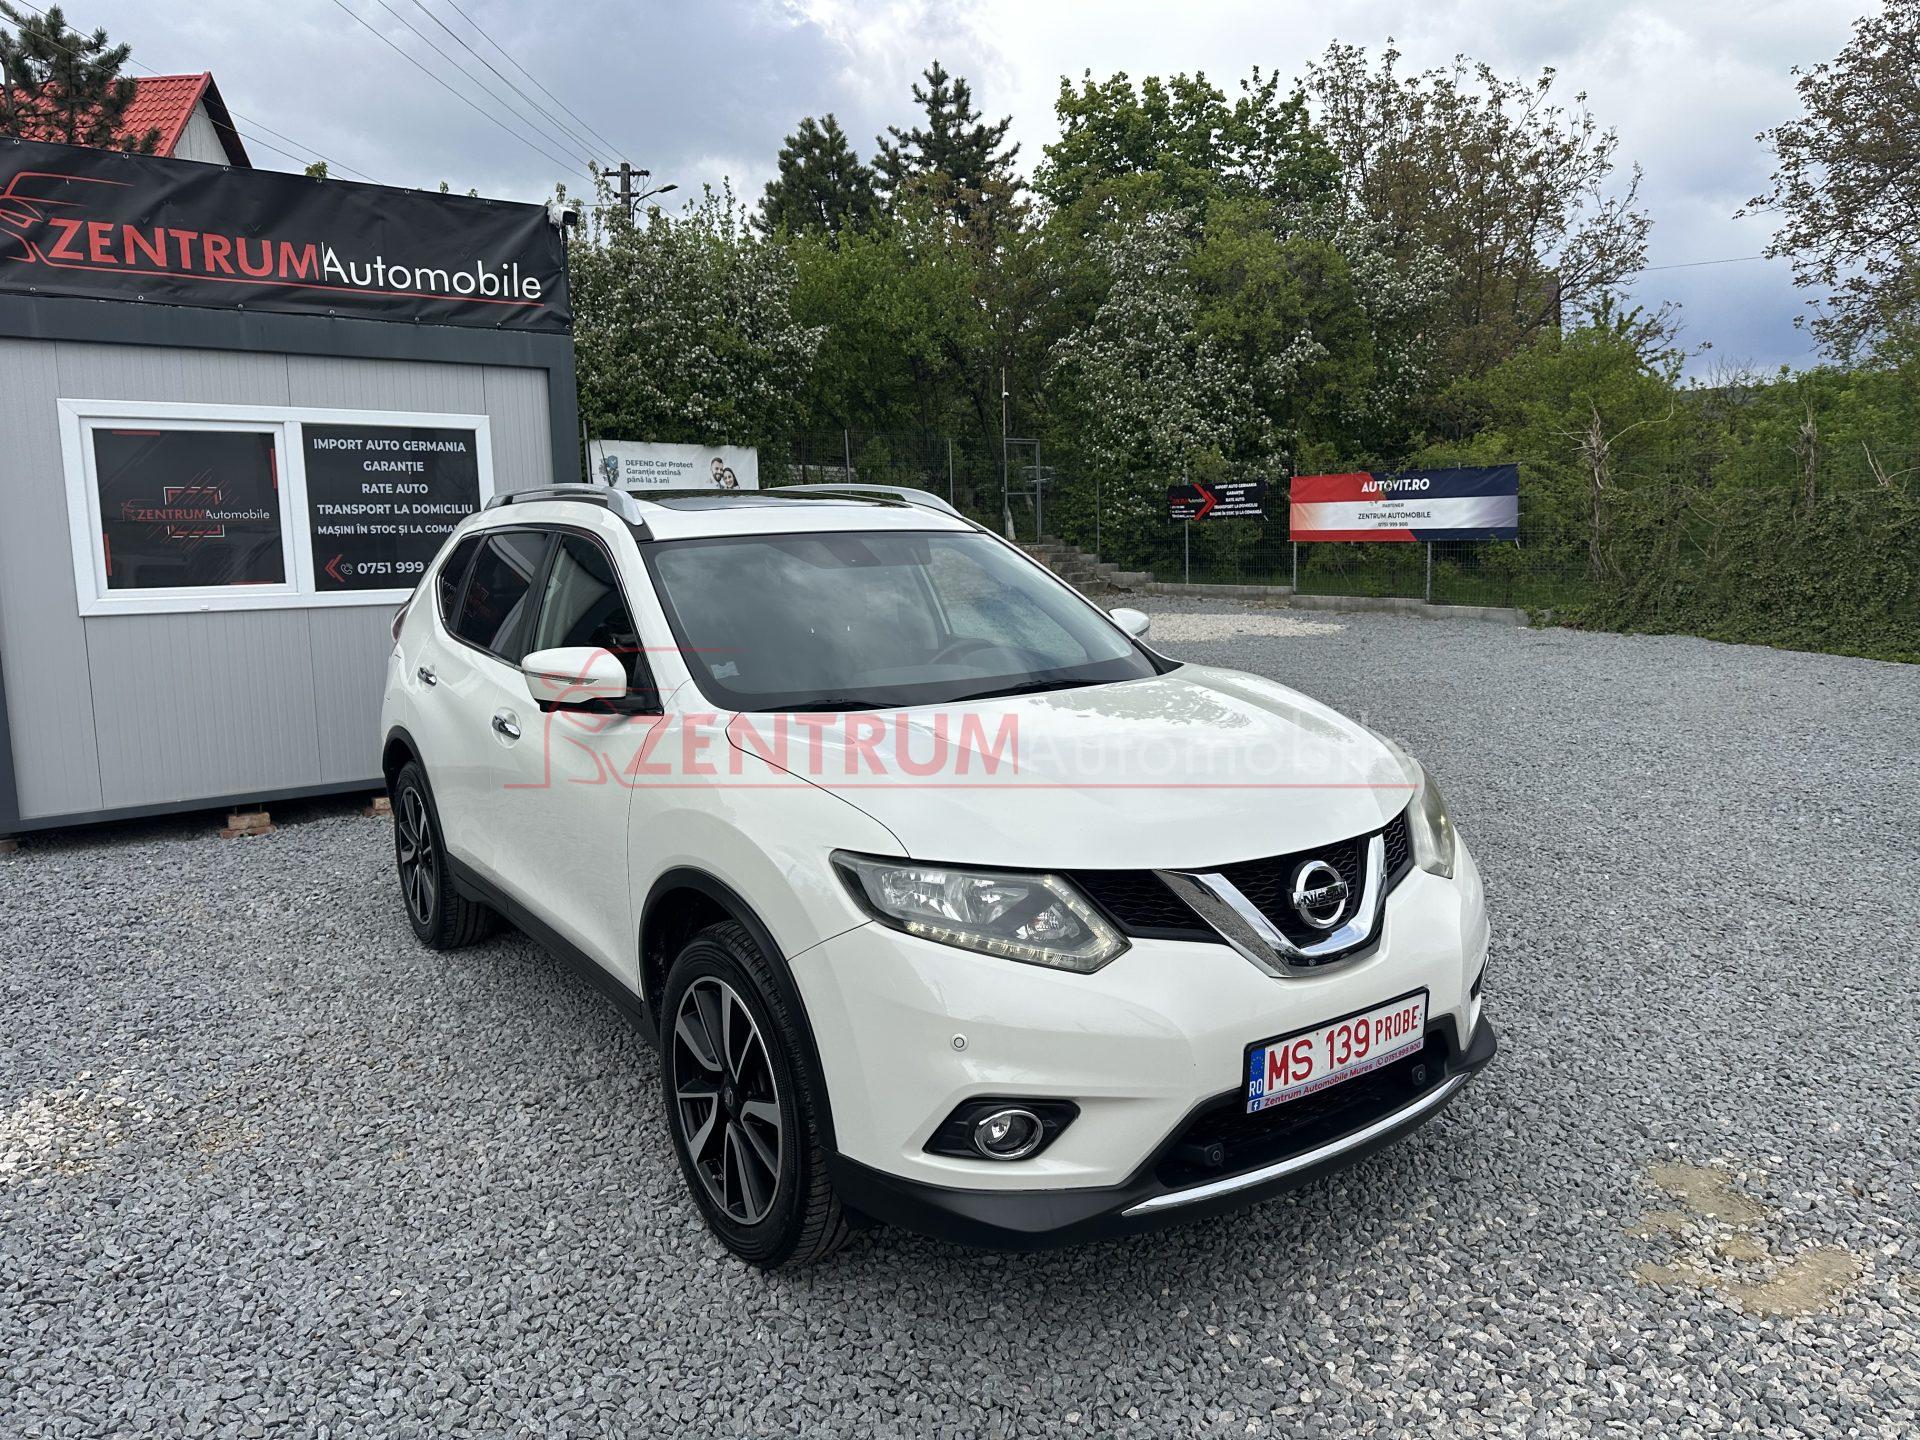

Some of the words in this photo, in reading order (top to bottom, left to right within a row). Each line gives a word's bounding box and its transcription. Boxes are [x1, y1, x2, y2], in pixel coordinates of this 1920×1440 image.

[49, 218, 319, 281] ZENTRUM
[321, 241, 541, 300] Automobile
[313, 438, 363, 450] IMPORT
[366, 440, 400, 451] AUTO
[403, 441, 466, 452] GERMANIA
[363, 461, 424, 474] GARANȚIE
[362, 483, 393, 494] RATE
[395, 483, 428, 494] AUTO
[1361, 478, 1430, 492] AUTOVIT.RO
[137, 508, 205, 520] ZENTRUM
[205, 507, 270, 519] Automobile
[317, 504, 391, 515] TRANSPORT
[394, 504, 409, 514] LA
[412, 504, 473, 514] DOMICILIU
[1358, 512, 1387, 520] ZENTRUM
[1387, 511, 1431, 519] AUTOMOBILE
[317, 525, 355, 537] MAȘINI
[357, 523, 368, 534] ÎN
[370, 525, 396, 534] STOC
[398, 524, 408, 536] ȘI
[410, 525, 423, 534] LA
[357, 562, 391, 574] 0751
[395, 561, 424, 573] 999
[1267, 1039, 1313, 1091] MS
[1325, 1018, 1370, 1070] 139
[1375, 1004, 1420, 1046] PROBE
[1248, 1078, 1263, 1097] RO
[1264, 1089, 1301, 1107] Zentrum
[1303, 1073, 1348, 1094] Automobile
[1349, 1063, 1373, 1076] Mures
